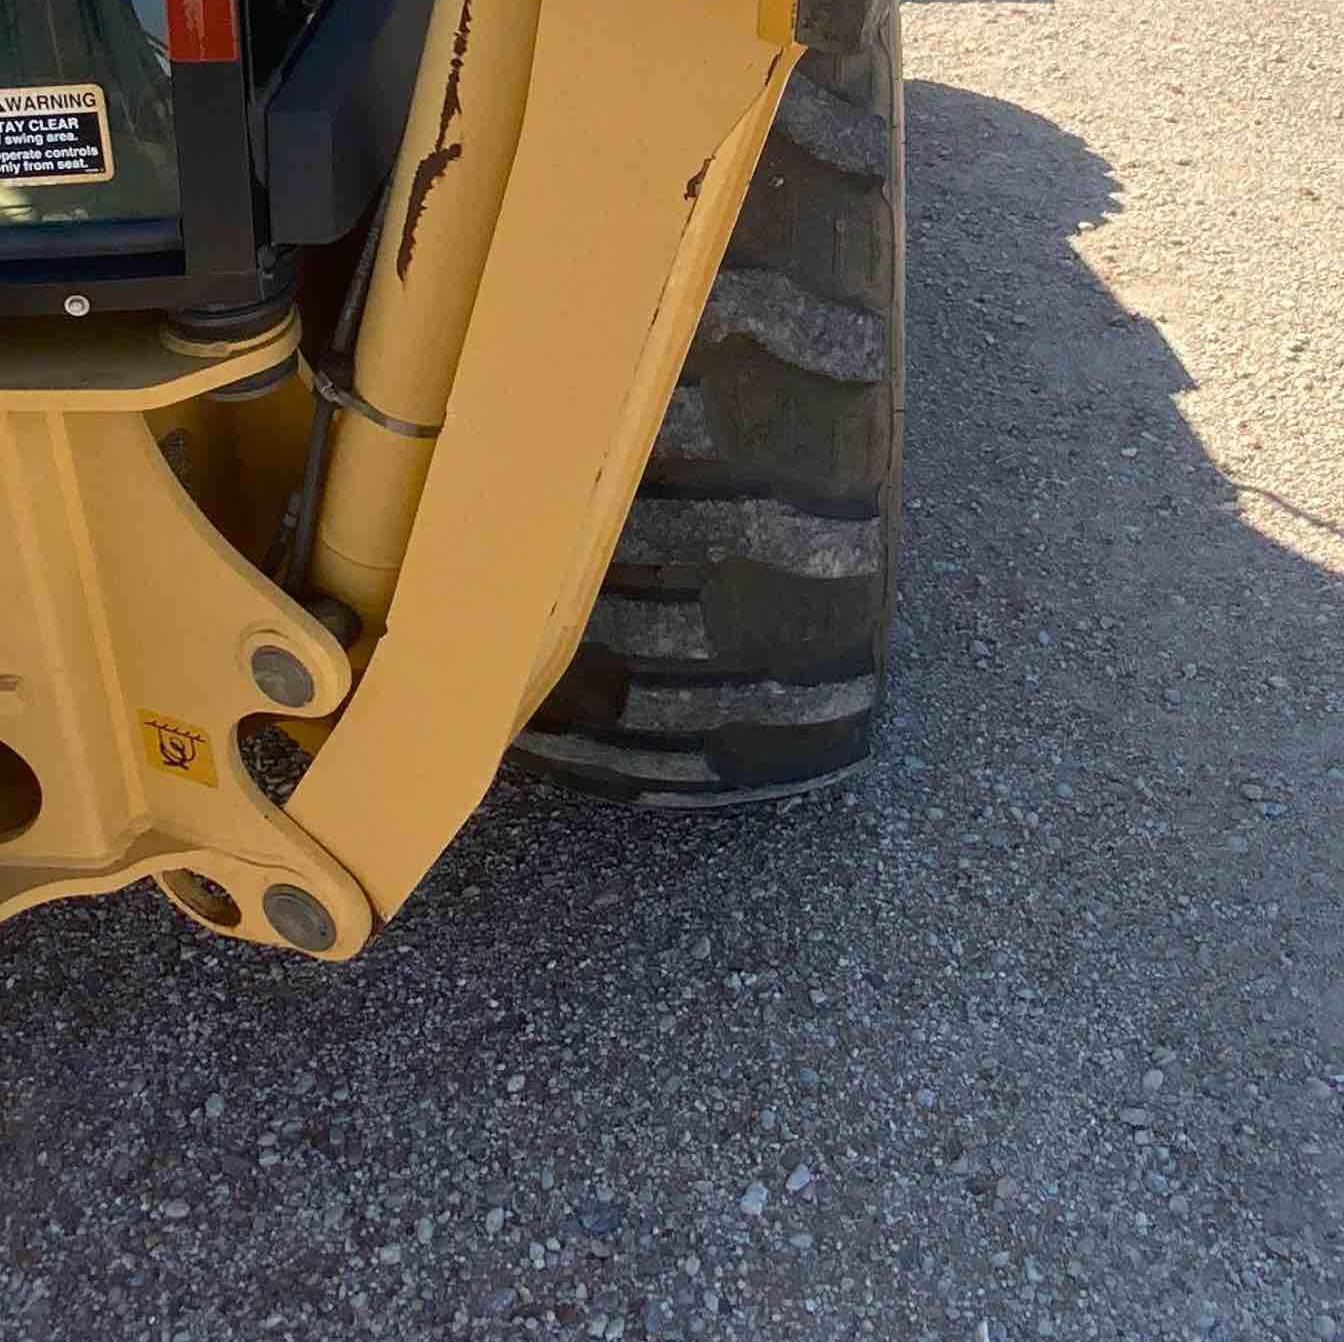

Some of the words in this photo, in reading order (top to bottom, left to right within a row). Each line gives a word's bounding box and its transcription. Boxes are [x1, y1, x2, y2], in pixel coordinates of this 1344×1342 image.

[4, 92, 96, 111] WARNING
[28, 117, 79, 132] CLEAR
[5, 132, 44, 146] swing
[46, 131, 78, 143] area.
[45, 145, 99, 160] controls
[23, 160, 54, 172] from
[57, 158, 89, 170] seat.
